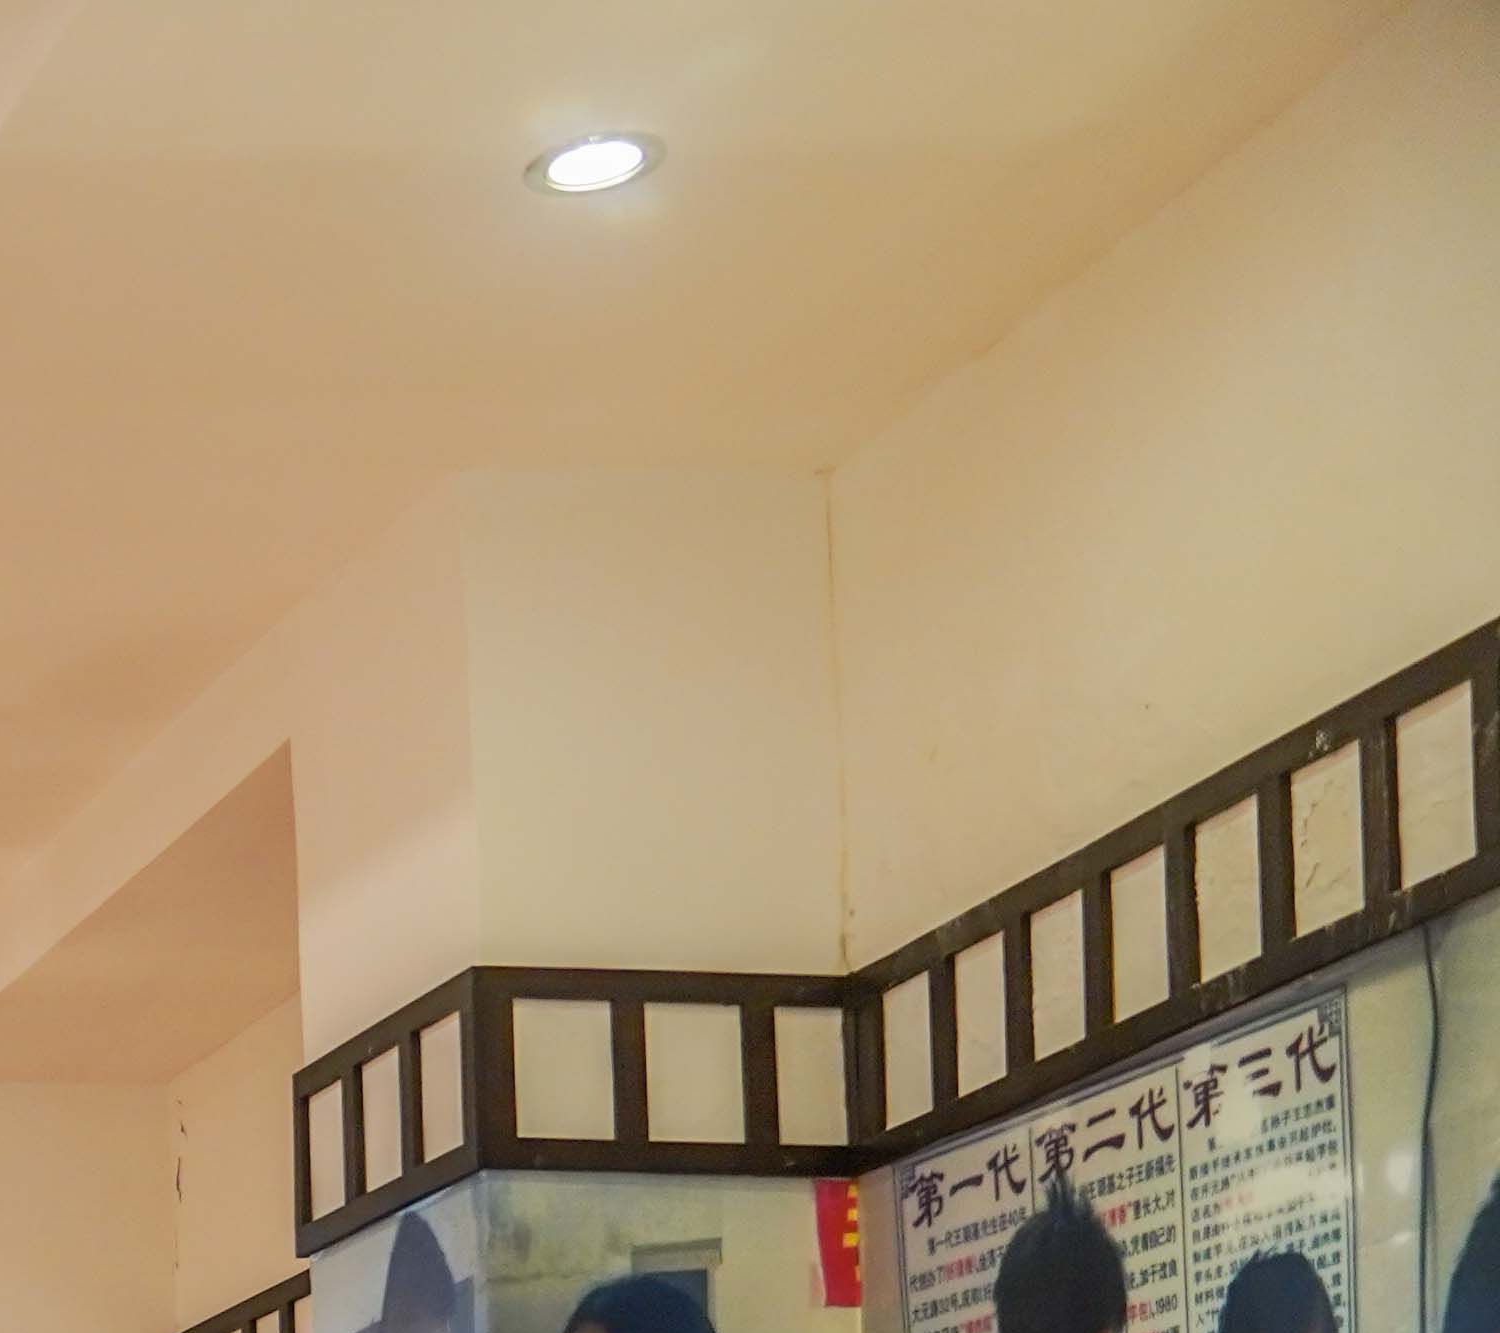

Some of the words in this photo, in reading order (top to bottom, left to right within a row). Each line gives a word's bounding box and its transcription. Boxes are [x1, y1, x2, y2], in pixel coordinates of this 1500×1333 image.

[1034, 1085, 1176, 1183] 第二代
[907, 1143, 1027, 1228] 第一代
